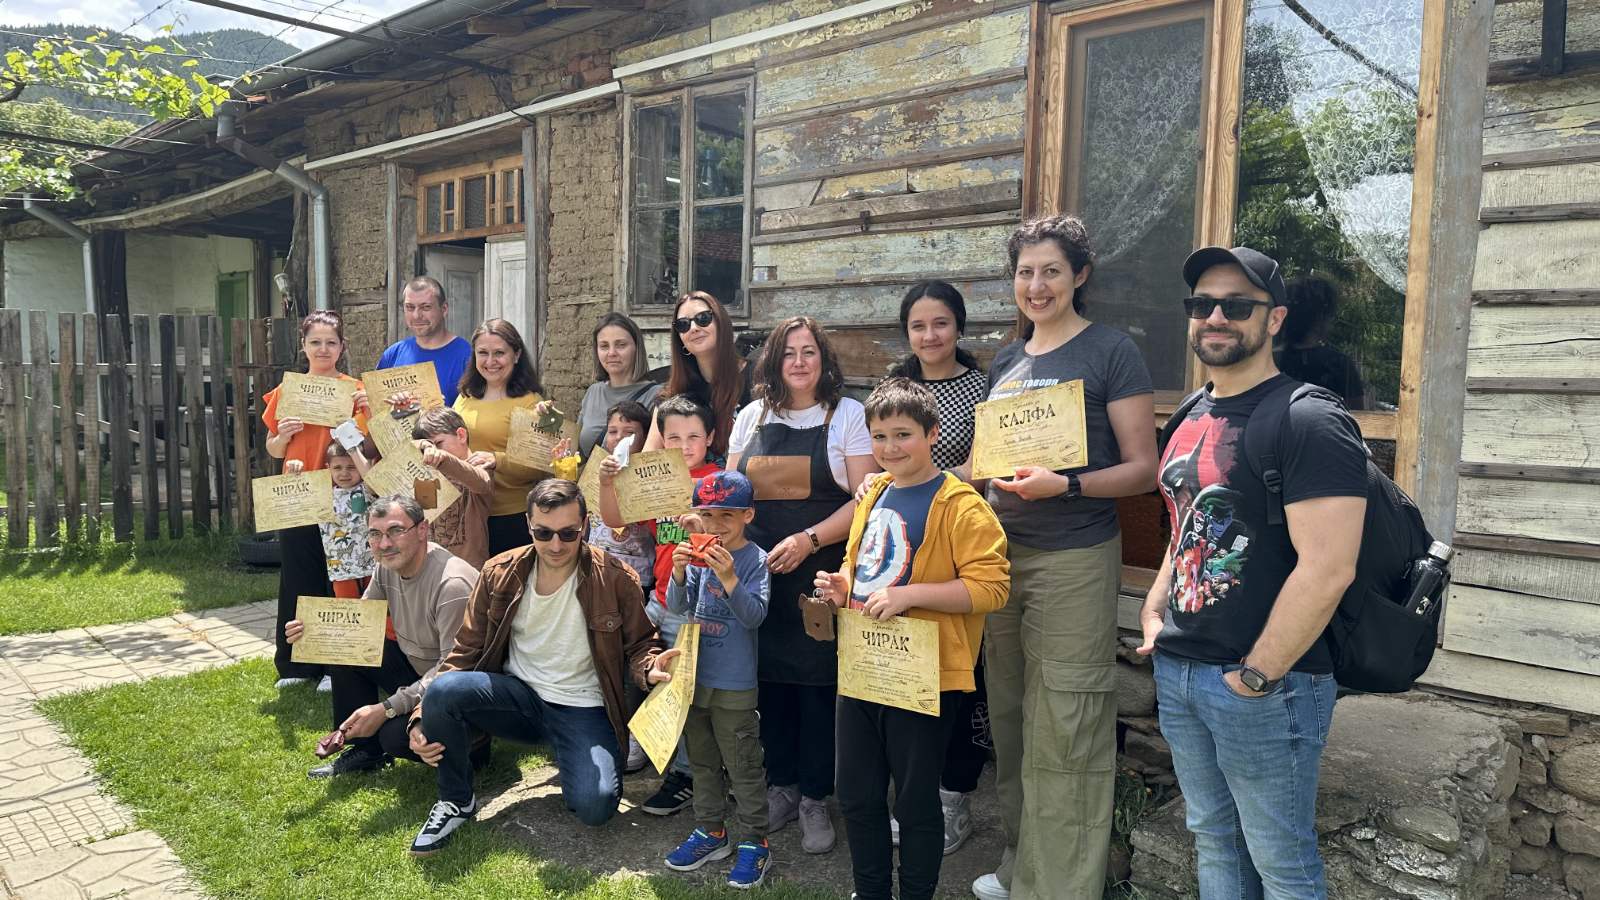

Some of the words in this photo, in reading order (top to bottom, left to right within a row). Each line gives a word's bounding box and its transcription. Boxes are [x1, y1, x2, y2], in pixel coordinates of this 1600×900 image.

[382, 375, 417, 388] ЧИРАК
[300, 383, 336, 397] ЧИРАК
[999, 403, 1056, 429] КАЛФА
[634, 463, 671, 479] ЧИРАК
[272, 481, 310, 497] ЧИРАК
[318, 611, 361, 624] ЧИРАК
[861, 630, 910, 652] ЧИРАК
